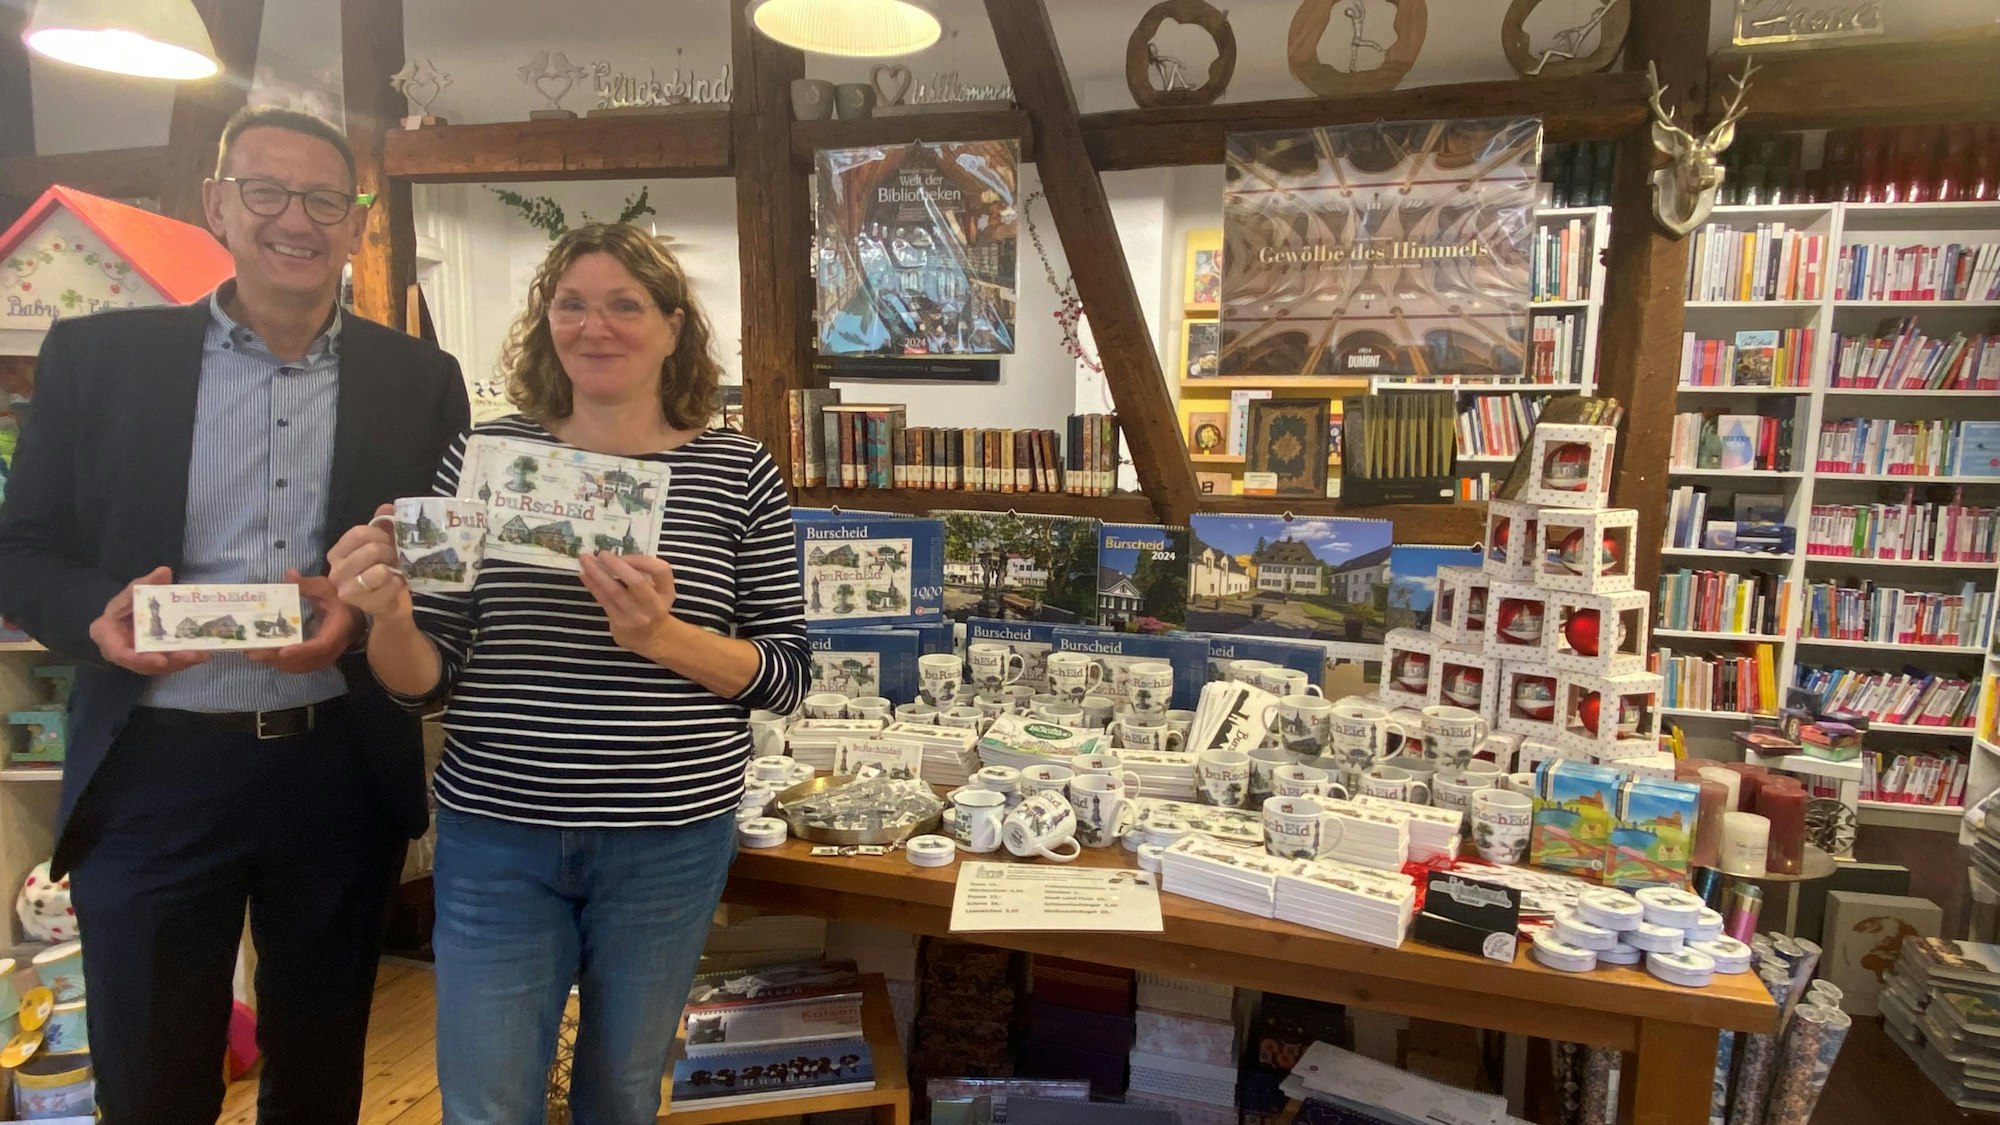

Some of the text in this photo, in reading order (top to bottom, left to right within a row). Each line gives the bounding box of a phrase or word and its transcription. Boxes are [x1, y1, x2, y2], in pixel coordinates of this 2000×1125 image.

[899, 174, 944, 186] Welt der
[877, 186, 961, 203] Bibliotheken
[1259, 239, 1489, 264] Gewölbe des Himmels
[7, 296, 60, 319] Baby
[904, 337, 927, 348] 2024
[1348, 354, 1381, 368] DUMONT
[806, 525, 869, 539] Burscheid
[1105, 538, 1165, 551] Burscheid
[1151, 551, 1176, 561] 2024
[912, 586, 943, 598] 1000
[973, 626, 1032, 641] Burscheid
[1060, 638, 1123, 654] Burscheid
